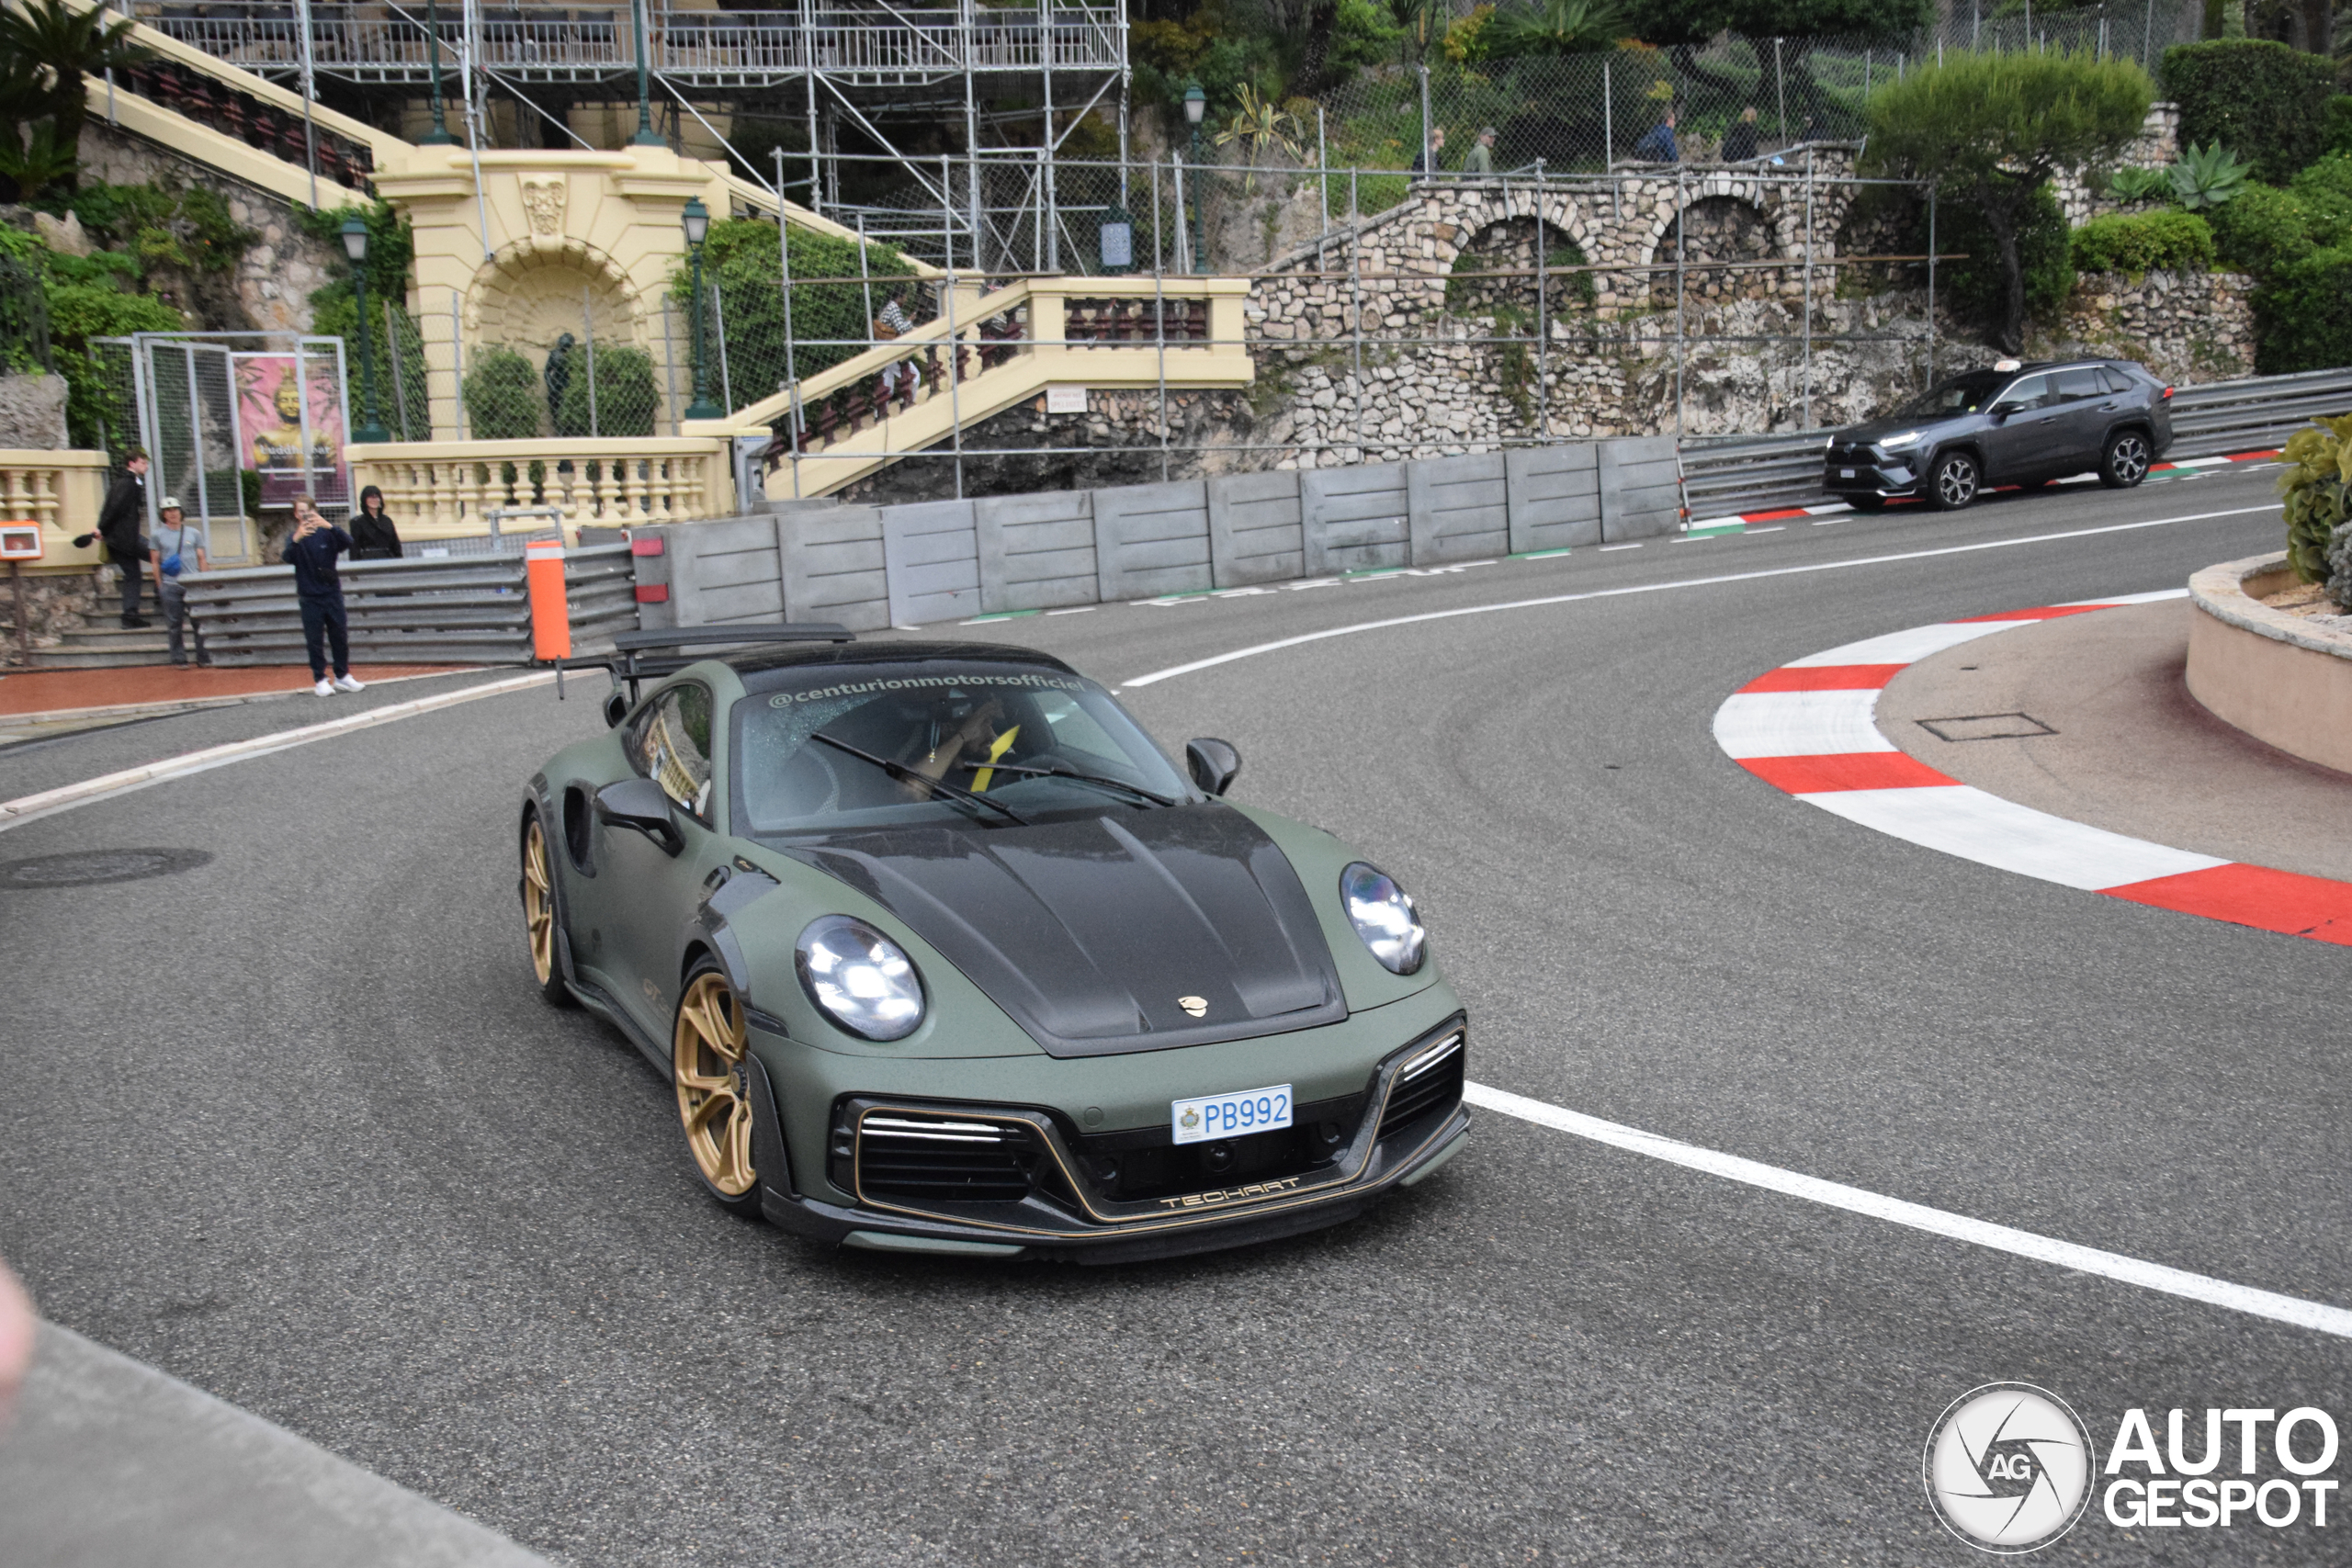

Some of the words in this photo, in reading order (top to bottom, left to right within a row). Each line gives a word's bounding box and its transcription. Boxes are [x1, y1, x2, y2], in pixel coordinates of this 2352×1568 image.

[769, 673, 1086, 709] @centurionmotorsofficiel
[1205, 1093, 1288, 1134] PB992
[1159, 1177, 1300, 1208] TECHART
